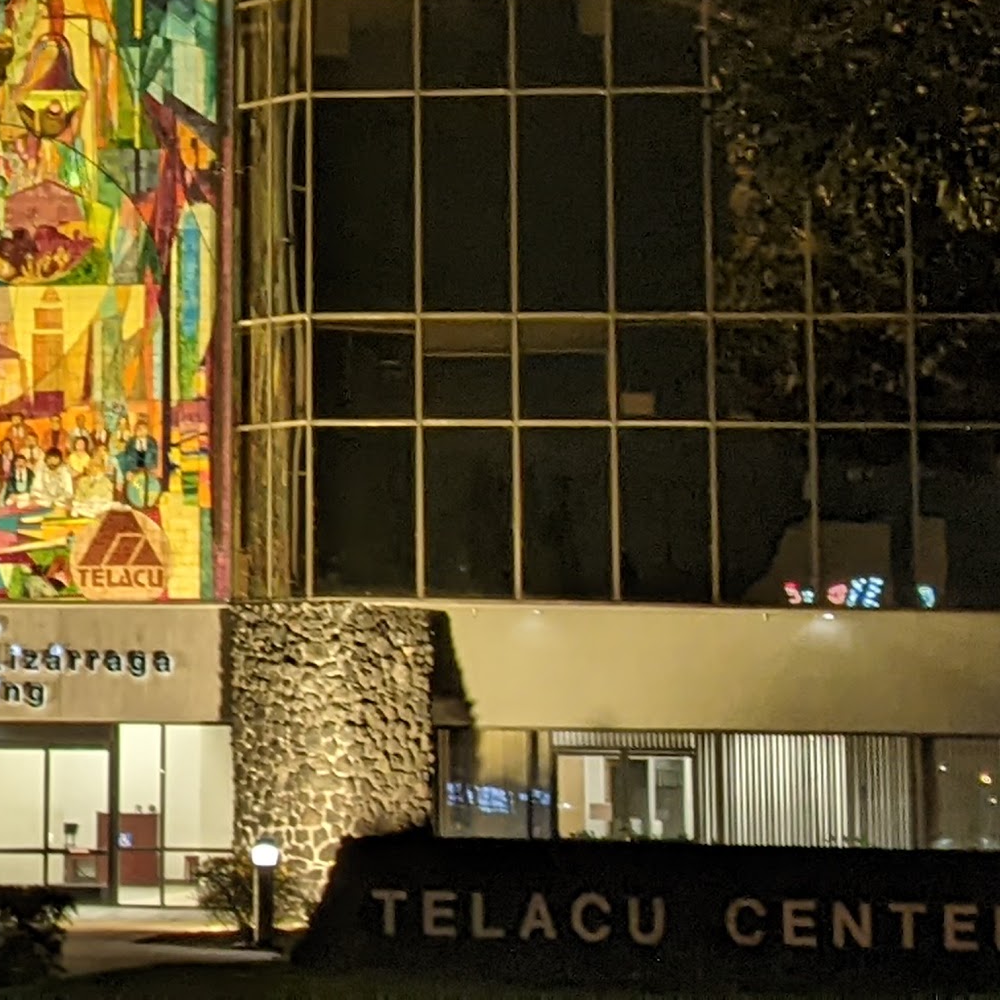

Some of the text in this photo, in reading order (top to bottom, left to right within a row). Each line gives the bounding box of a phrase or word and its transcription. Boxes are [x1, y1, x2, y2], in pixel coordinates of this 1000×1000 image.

[78, 568, 164, 588] TELACU
[371, 888, 1000, 952] TELACU CENTE
